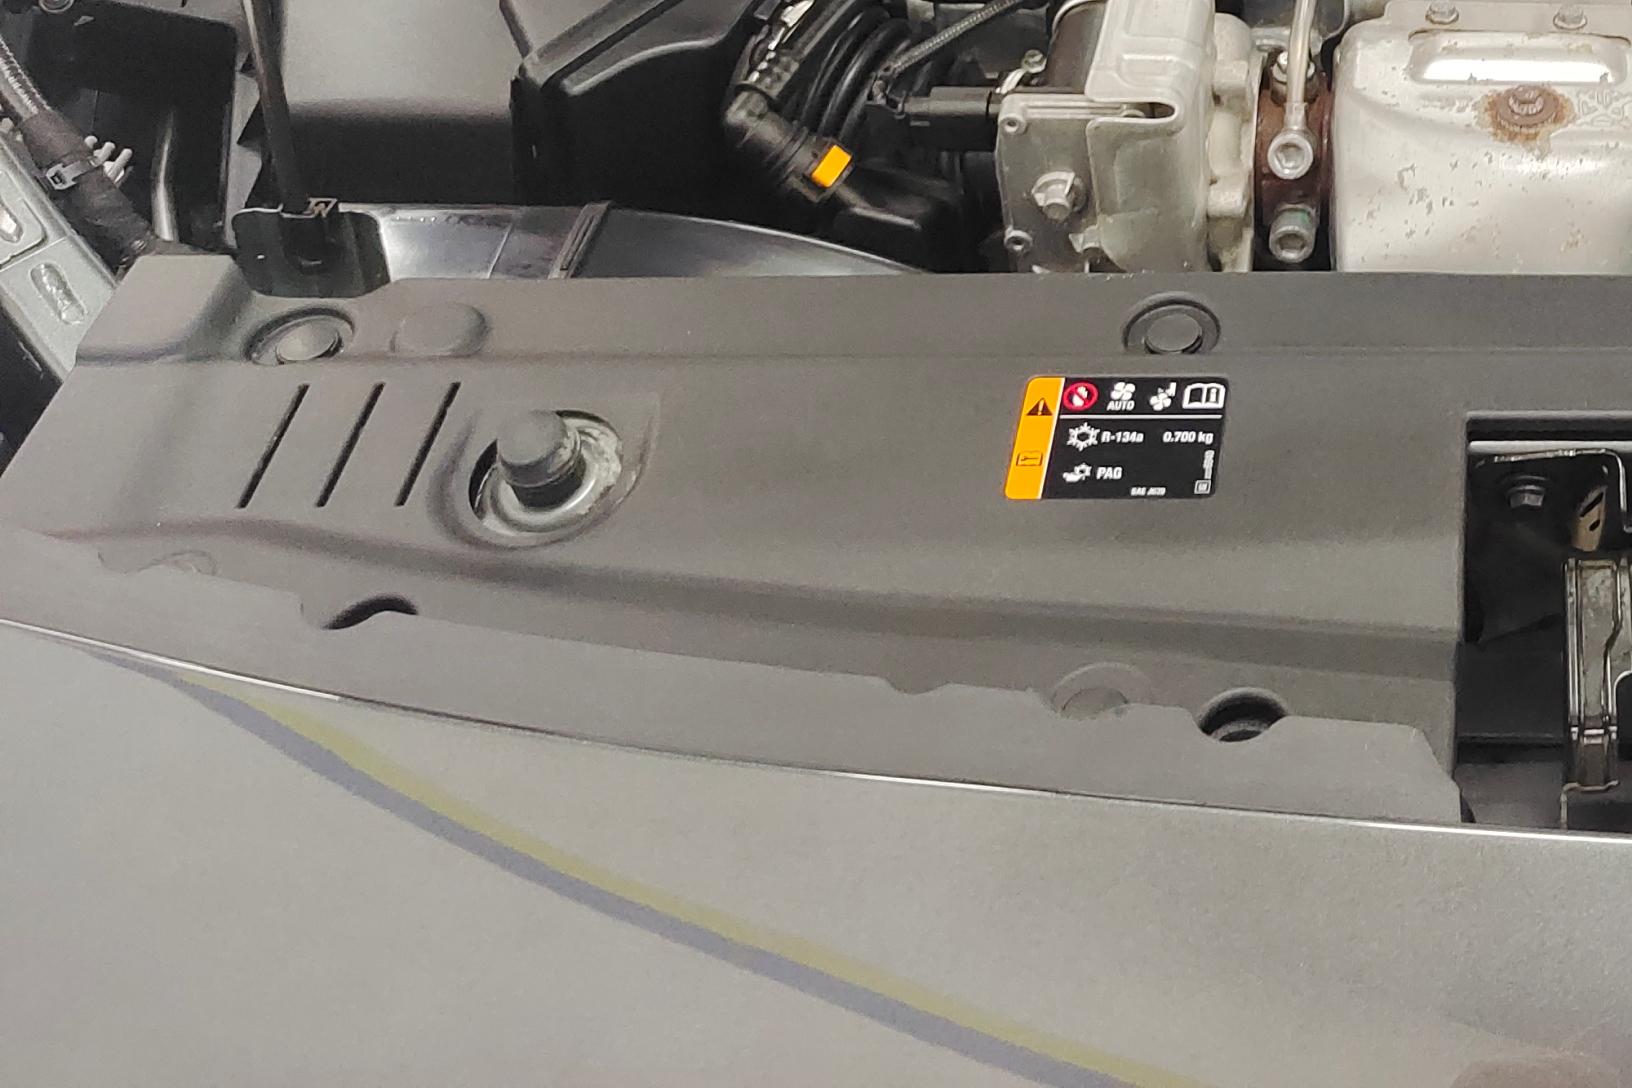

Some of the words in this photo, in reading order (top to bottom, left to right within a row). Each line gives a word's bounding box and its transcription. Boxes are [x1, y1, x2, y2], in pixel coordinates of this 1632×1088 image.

[1106, 400, 1135, 411] AUTO
[1101, 431, 1144, 443] R-134a
[1163, 431, 1196, 443] 0.700
[1197, 431, 1214, 444] kg
[1096, 466, 1123, 480] PAG
